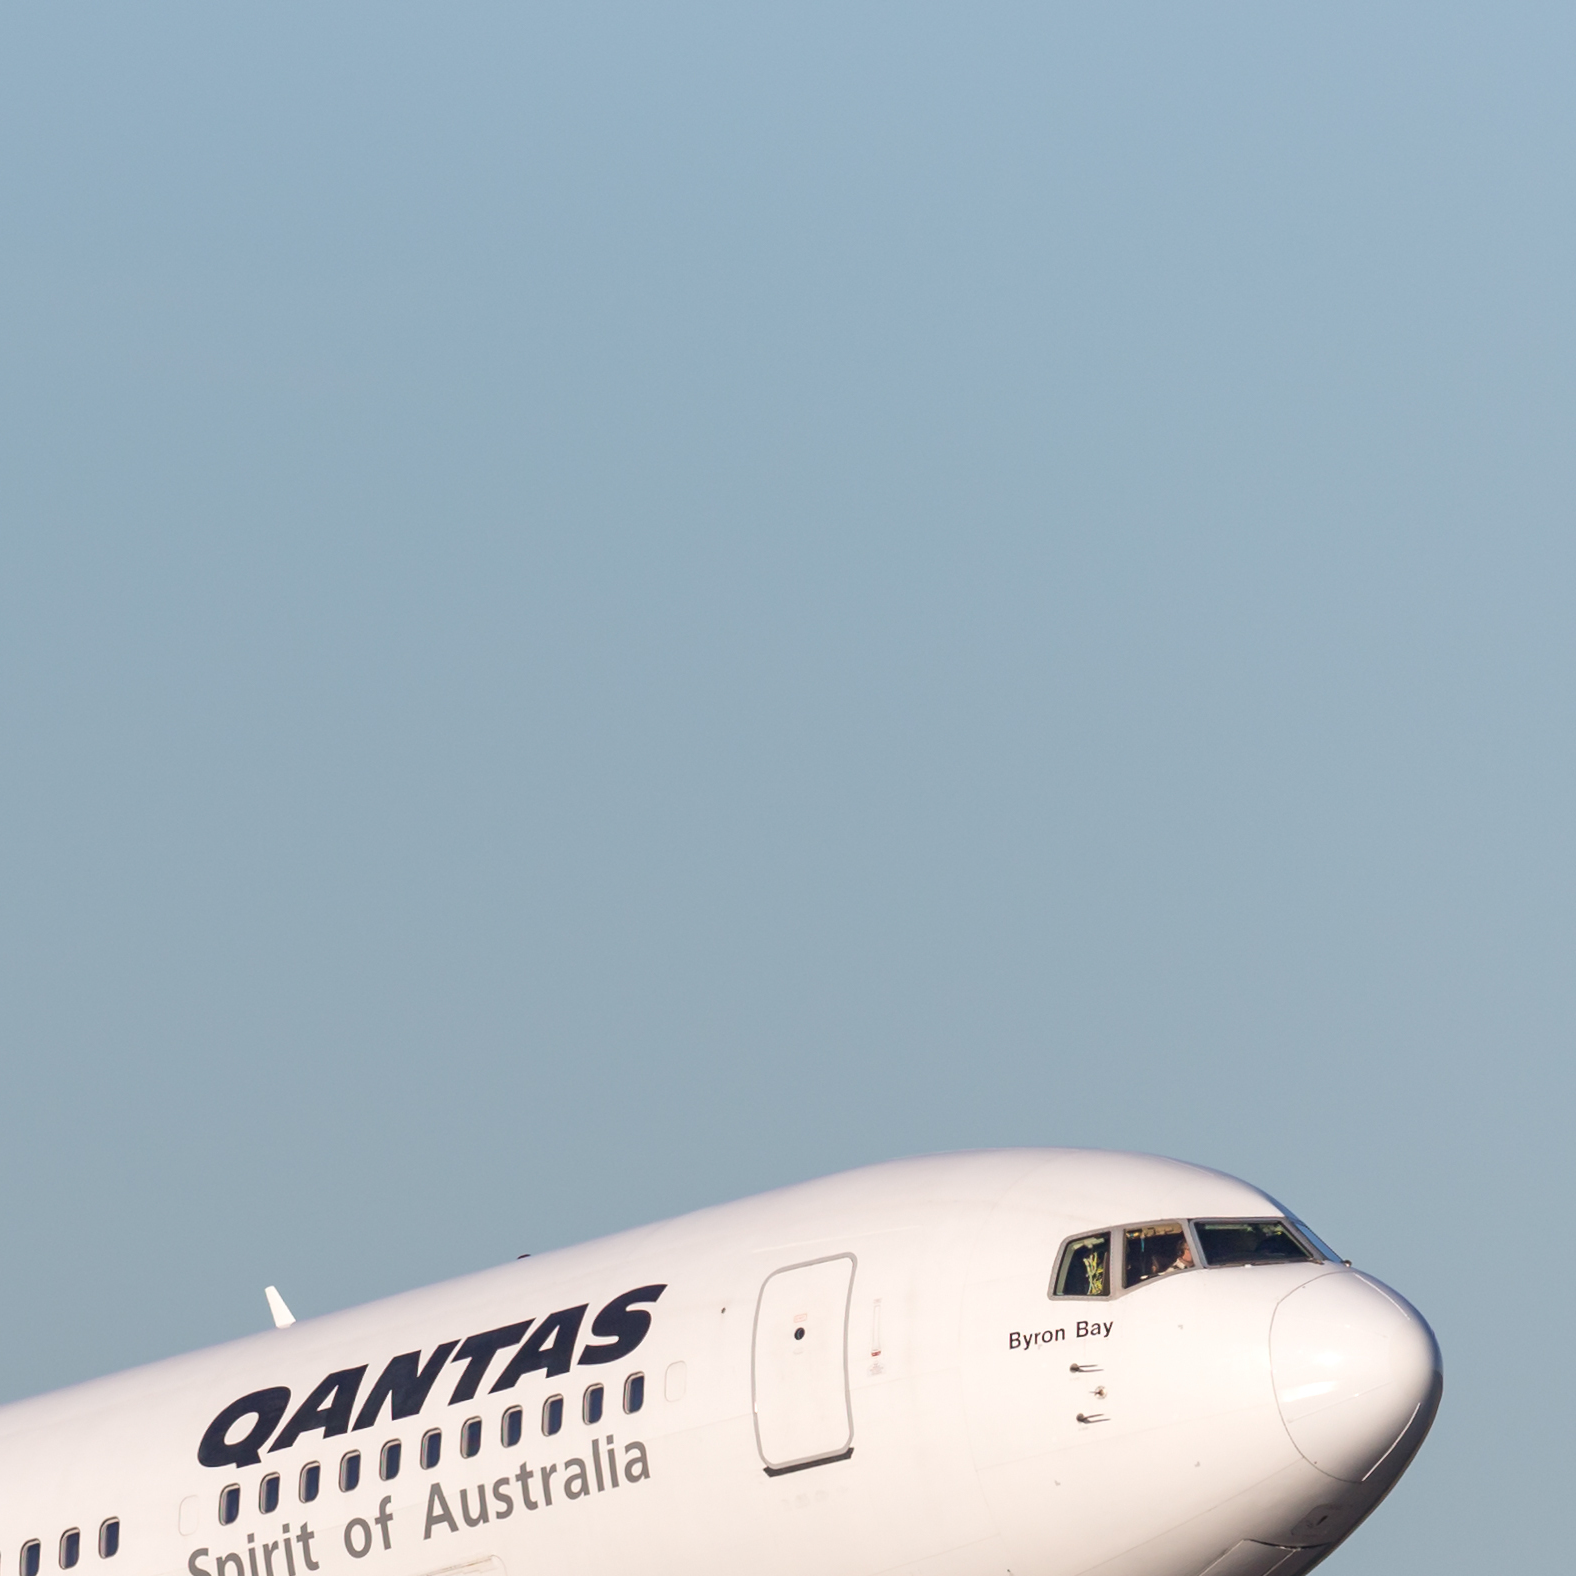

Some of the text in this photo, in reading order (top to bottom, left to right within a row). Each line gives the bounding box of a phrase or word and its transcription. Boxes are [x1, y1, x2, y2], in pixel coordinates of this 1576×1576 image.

[197, 1284, 668, 1469] QANTAS
[1009, 1320, 1114, 1350] Byron Bay
[343, 1495, 394, 1560] of
[423, 1434, 651, 1541] Australia
